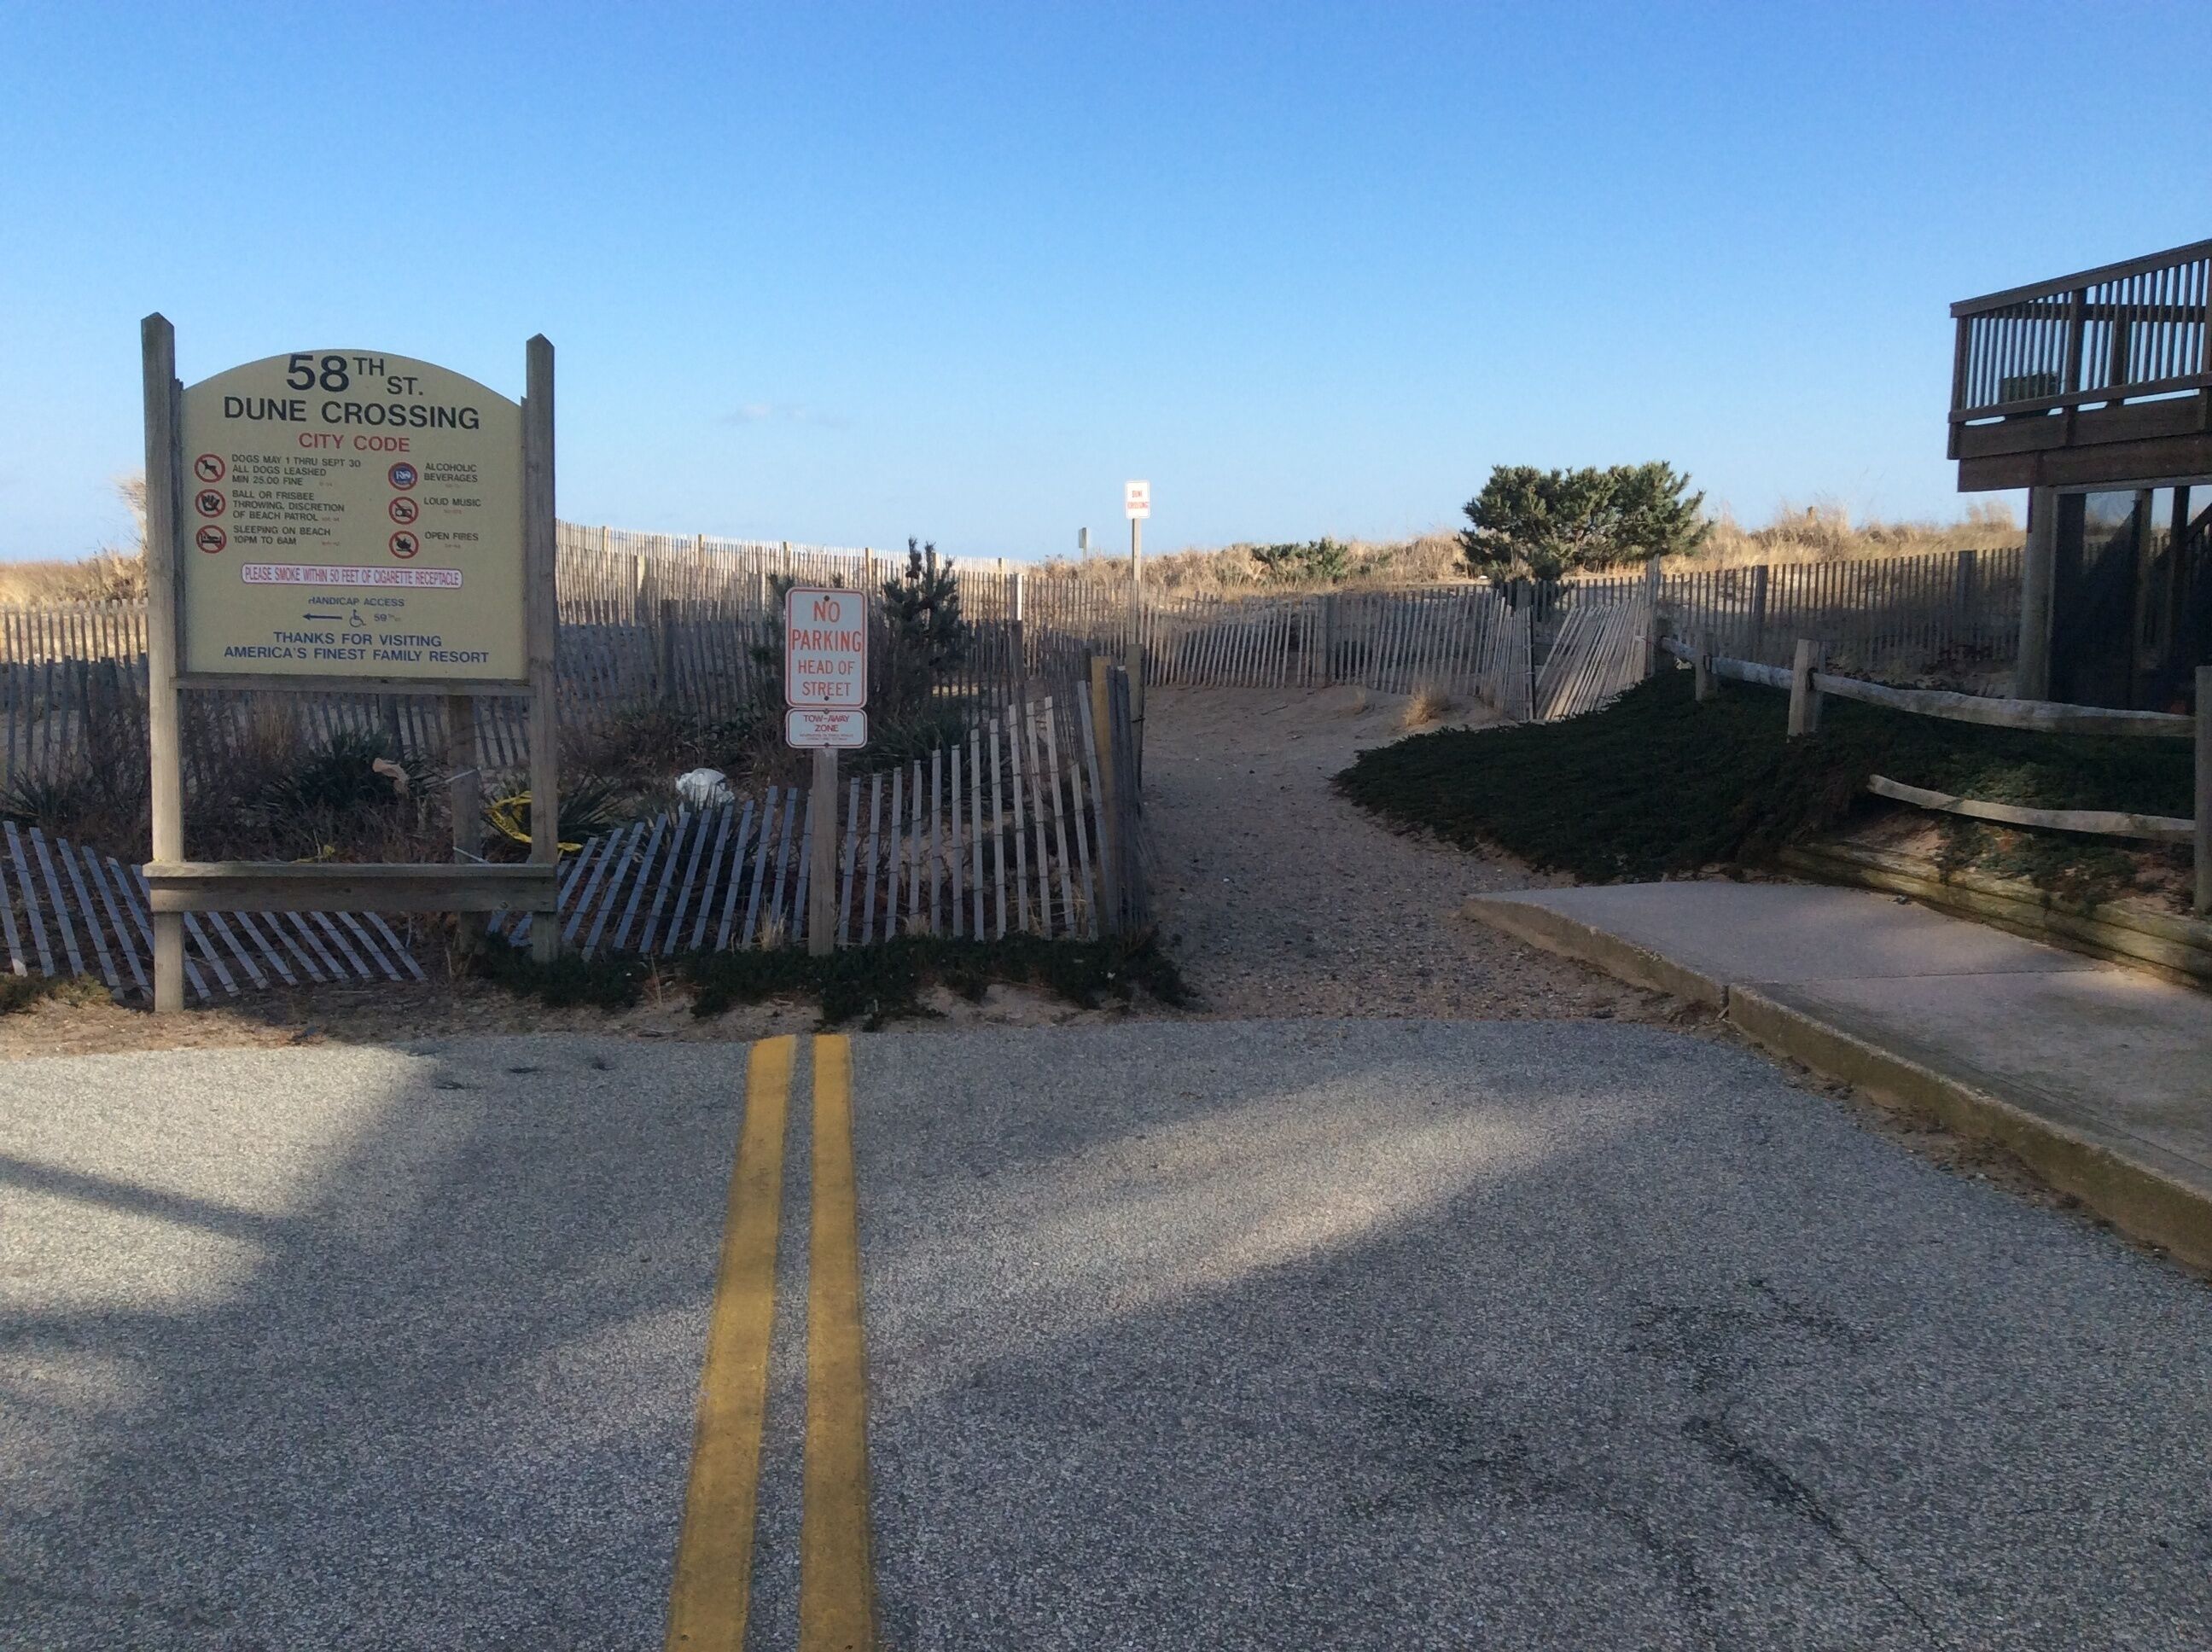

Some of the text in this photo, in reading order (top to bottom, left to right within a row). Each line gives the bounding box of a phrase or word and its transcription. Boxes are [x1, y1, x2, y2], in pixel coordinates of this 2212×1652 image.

[387, 375, 423, 396] ST.
[224, 396, 480, 430] DUNE CROSSING
[298, 432, 410, 452] CITY CODE
[231, 454, 259, 463] DOGS
[263, 456, 282, 464] MAY
[294, 457, 318, 465] THRU
[321, 458, 346, 468] SEPT
[348, 459, 361, 468] 30
[425, 462, 477, 472] ALCOHOLIC
[232, 464, 326, 476] ALL DOGS LEASHED
[232, 474, 249, 484] MIN
[282, 477, 303, 486] FINE
[423, 472, 478, 483] BEVERAGES
[232, 489, 314, 501] BALL OR FRISBEE
[288, 502, 345, 512] DISCRETION
[423, 497, 481, 507] LOUD MUSIC
[232, 510, 245, 519] OF
[249, 511, 281, 520] BEACH
[284, 512, 318, 521] PATROL
[233, 525, 331, 536] SLEEPING ON BEACH
[424, 531, 479, 541] OPEN FIRES
[234, 535, 297, 545] 10PM TO 6AM
[245, 566, 459, 585] PLEASE SMOKE WITHIN 50 FEET OF CIGARETTE RECEPTACLE
[307, 596, 405, 607] HANDICAP ACCESS
[813, 600, 841, 623] NO
[273, 631, 443, 647] THANKS FOR VISITING
[791, 629, 862, 652] PARKING
[224, 646, 489, 663] AMERICA'S FINEST FAMILY RESORT
[798, 660, 855, 675] HEAD OF
[801, 681, 852, 697] STREET
[803, 714, 850, 723] TOW-AWAY
